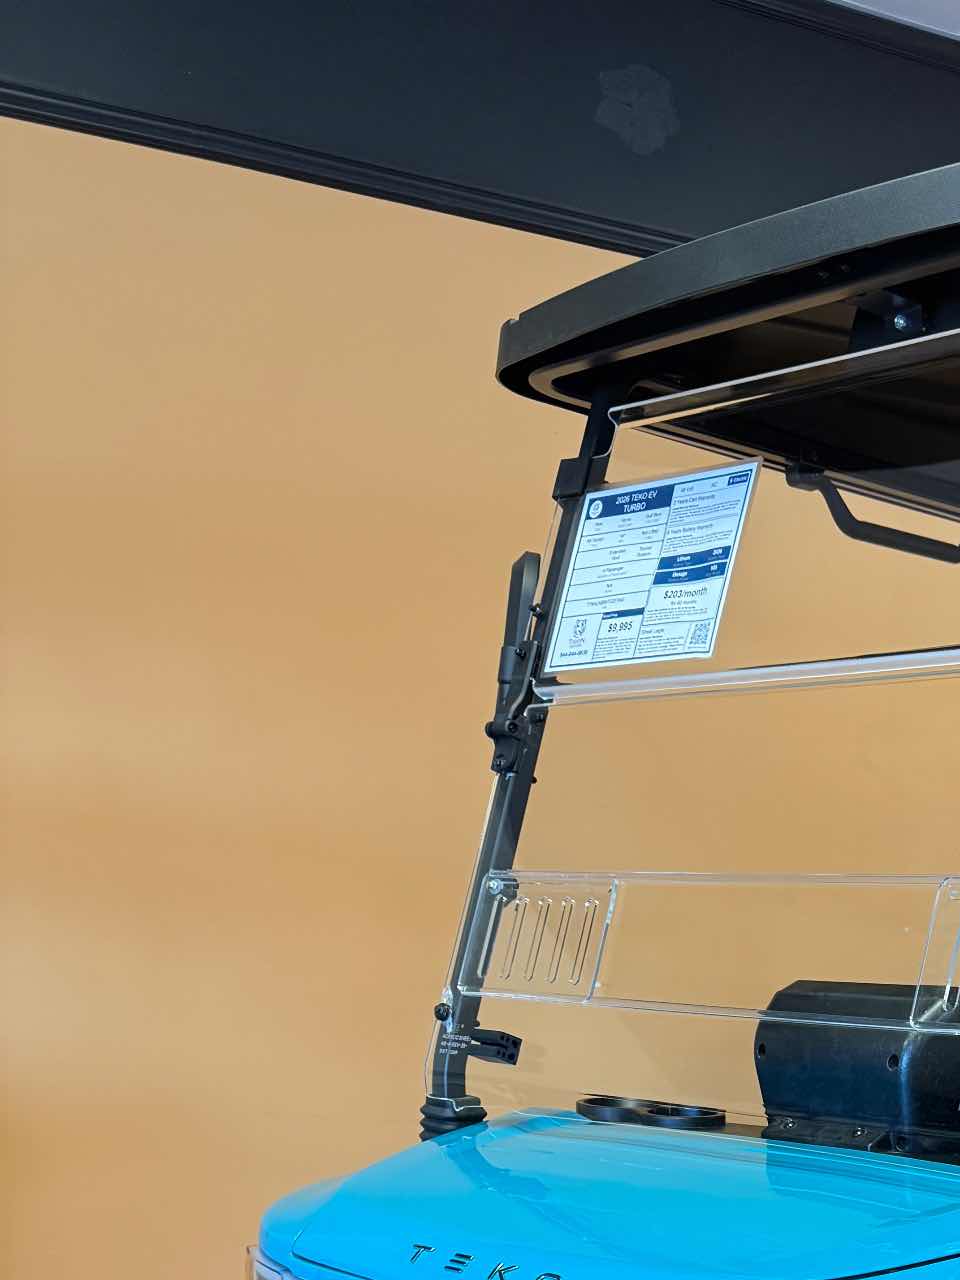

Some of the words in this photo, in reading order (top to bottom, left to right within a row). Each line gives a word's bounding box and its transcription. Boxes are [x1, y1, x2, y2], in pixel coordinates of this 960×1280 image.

[616, 495, 631, 505] 2026
[632, 493, 648, 502] TEKO
[648, 490, 658, 499] EV
[623, 502, 647, 513] TURBO
[663, 587, 708, 599] $203/month
[607, 620, 633, 633] $9,995
